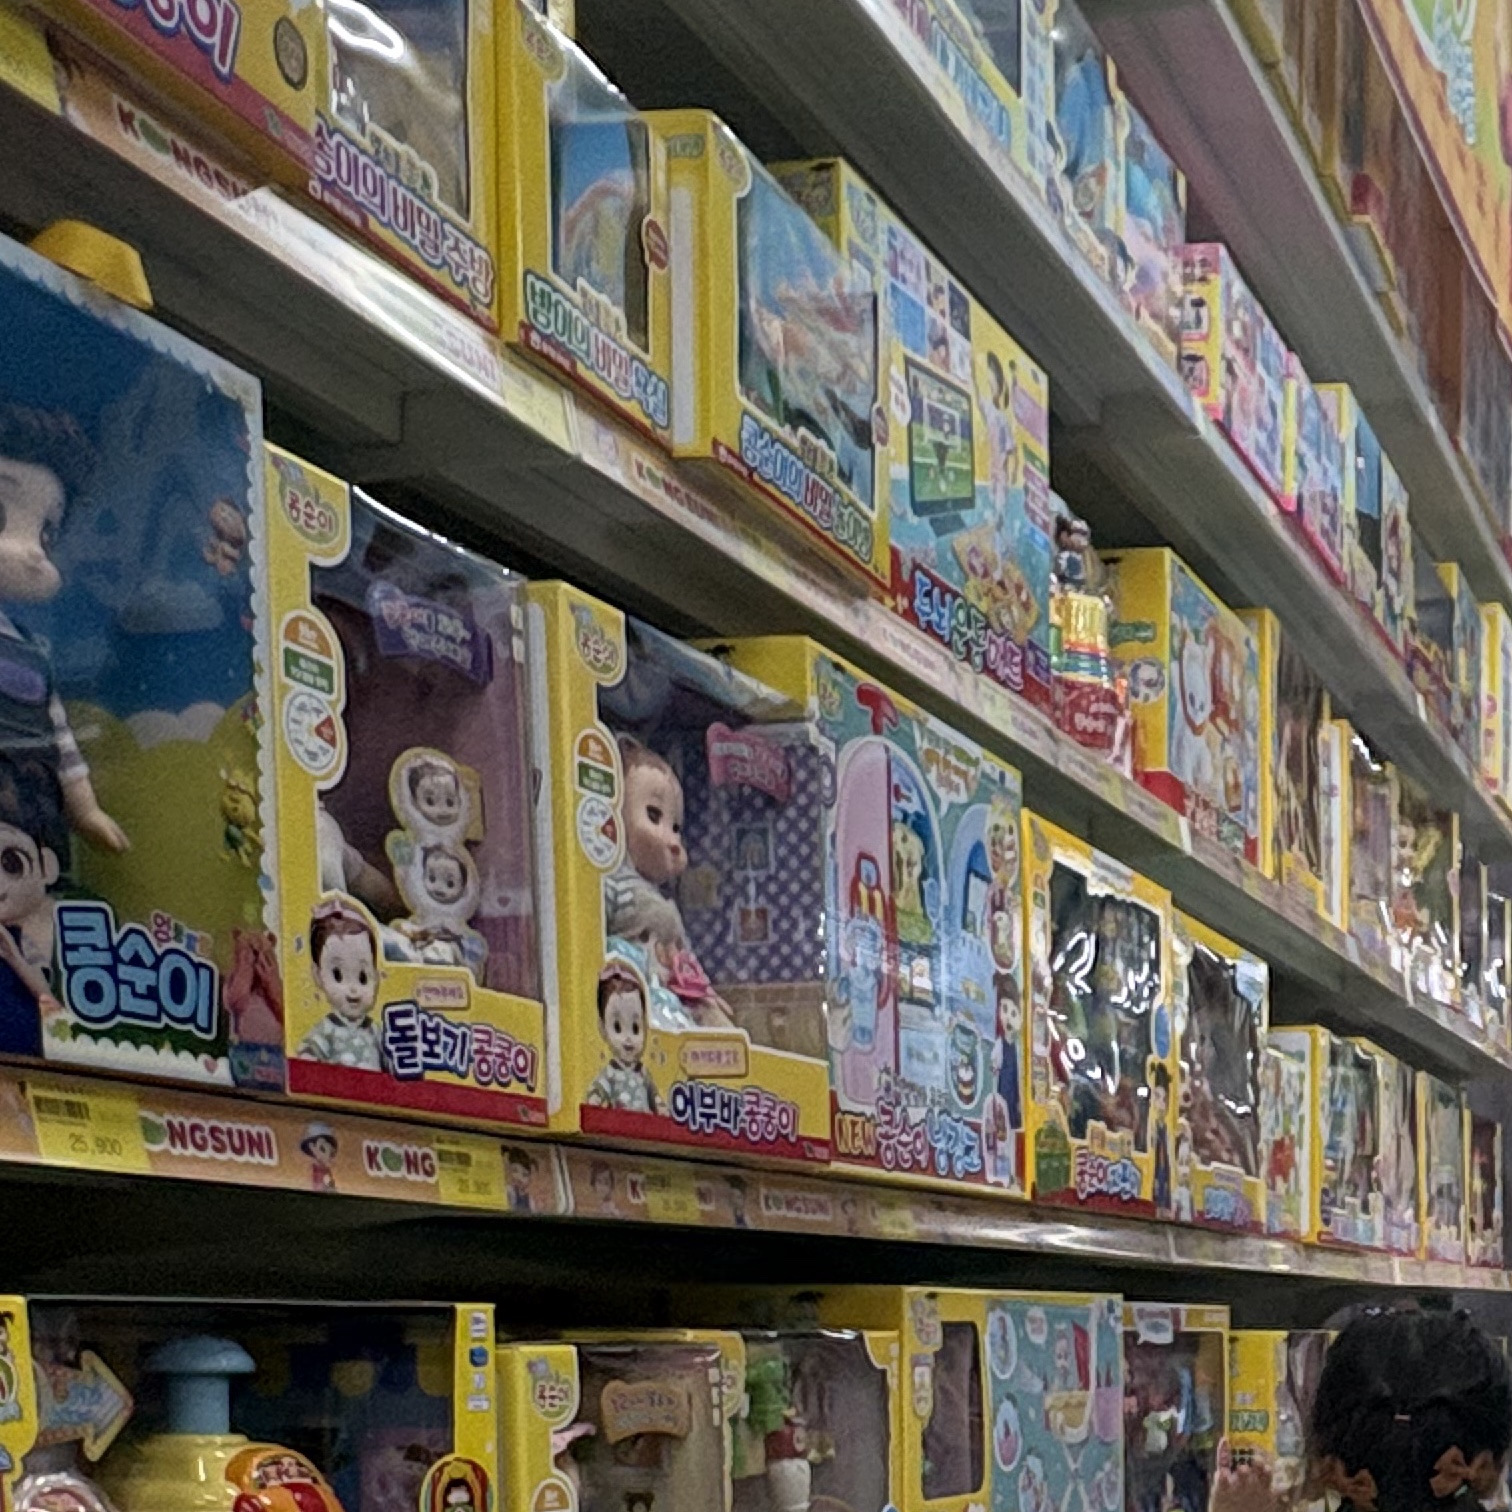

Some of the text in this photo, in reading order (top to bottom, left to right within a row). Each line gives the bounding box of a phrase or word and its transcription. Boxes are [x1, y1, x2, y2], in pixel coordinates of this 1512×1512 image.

[60, 905, 216, 1032] 콩순이
[386, 1002, 538, 1087] 돌보기 콩콩이
[671, 1083, 798, 1141] 어부바 콩콩이
[836, 1113, 876, 1156] NEW
